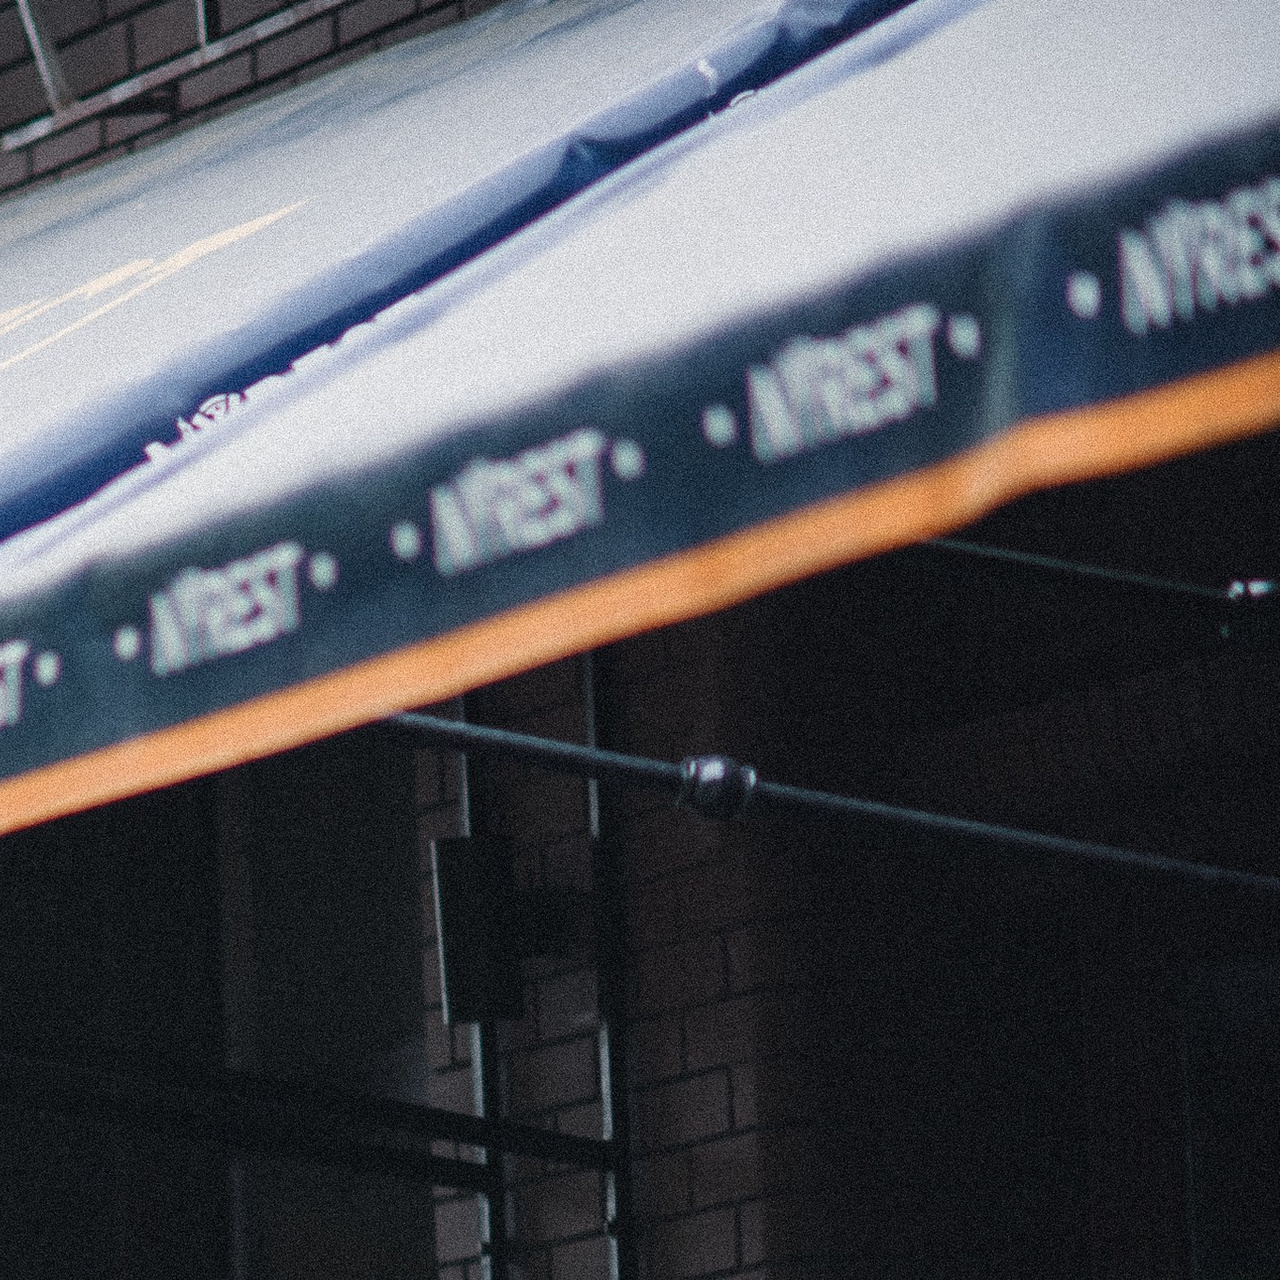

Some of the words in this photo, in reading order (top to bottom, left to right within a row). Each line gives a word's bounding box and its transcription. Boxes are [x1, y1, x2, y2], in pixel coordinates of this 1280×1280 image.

[151, 542, 303, 676] NYREST
[430, 427, 608, 576] NYREST
[748, 303, 939, 463] NYREST
